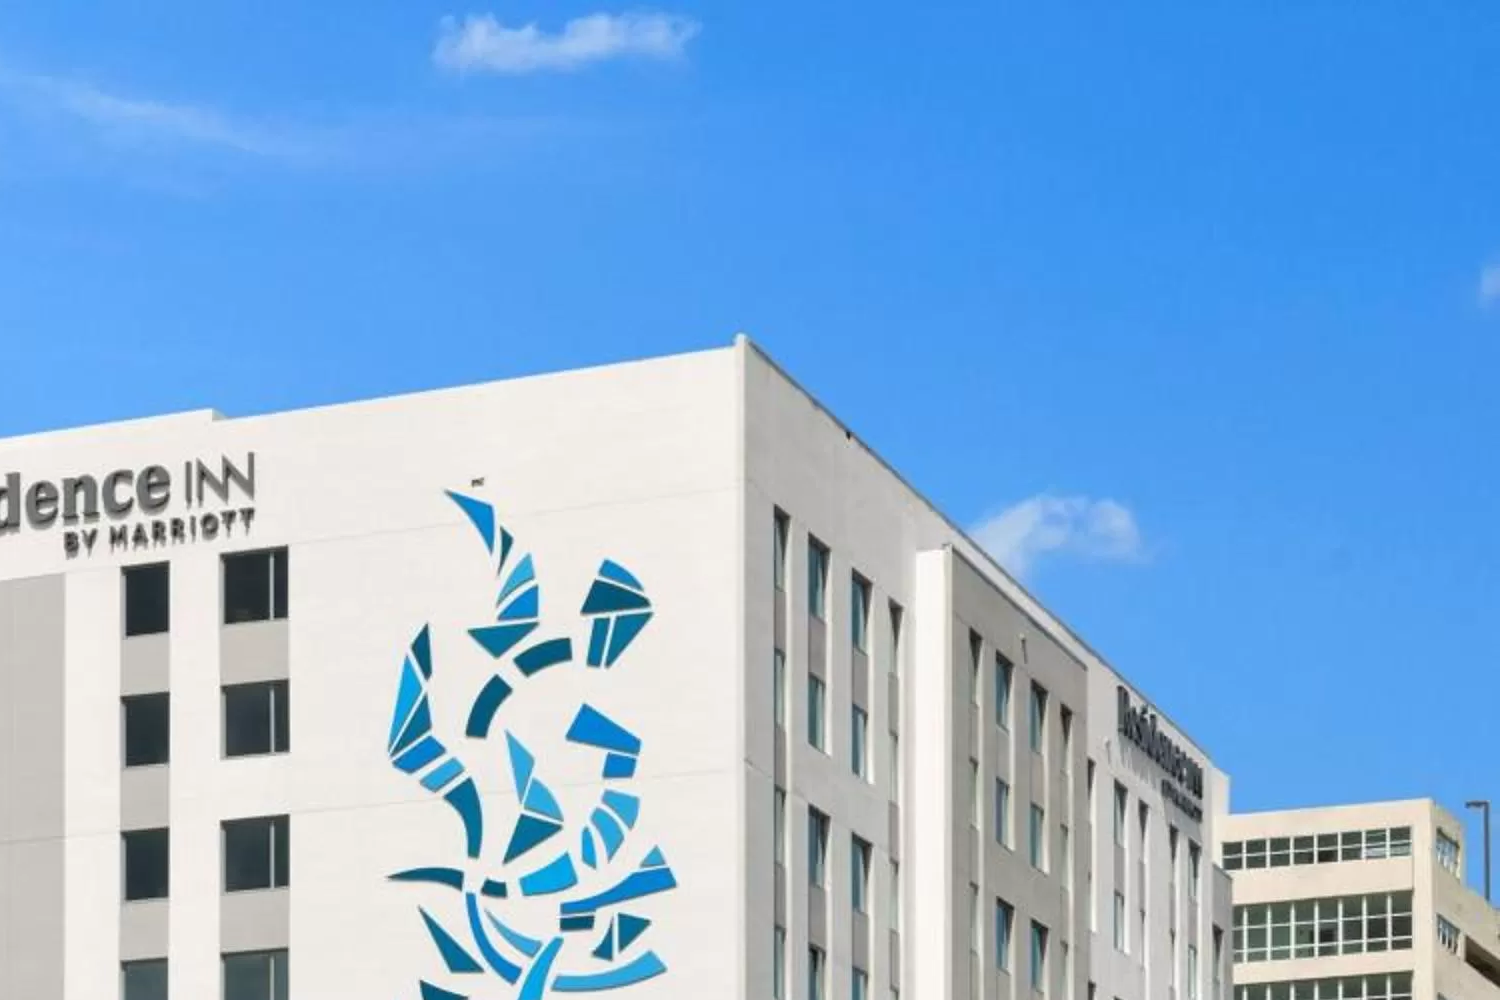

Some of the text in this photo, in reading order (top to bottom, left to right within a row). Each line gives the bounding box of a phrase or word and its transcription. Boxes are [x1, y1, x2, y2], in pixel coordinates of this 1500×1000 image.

[184, 451, 256, 508] INN
[63, 507, 256, 559] BY MARRIOTT
